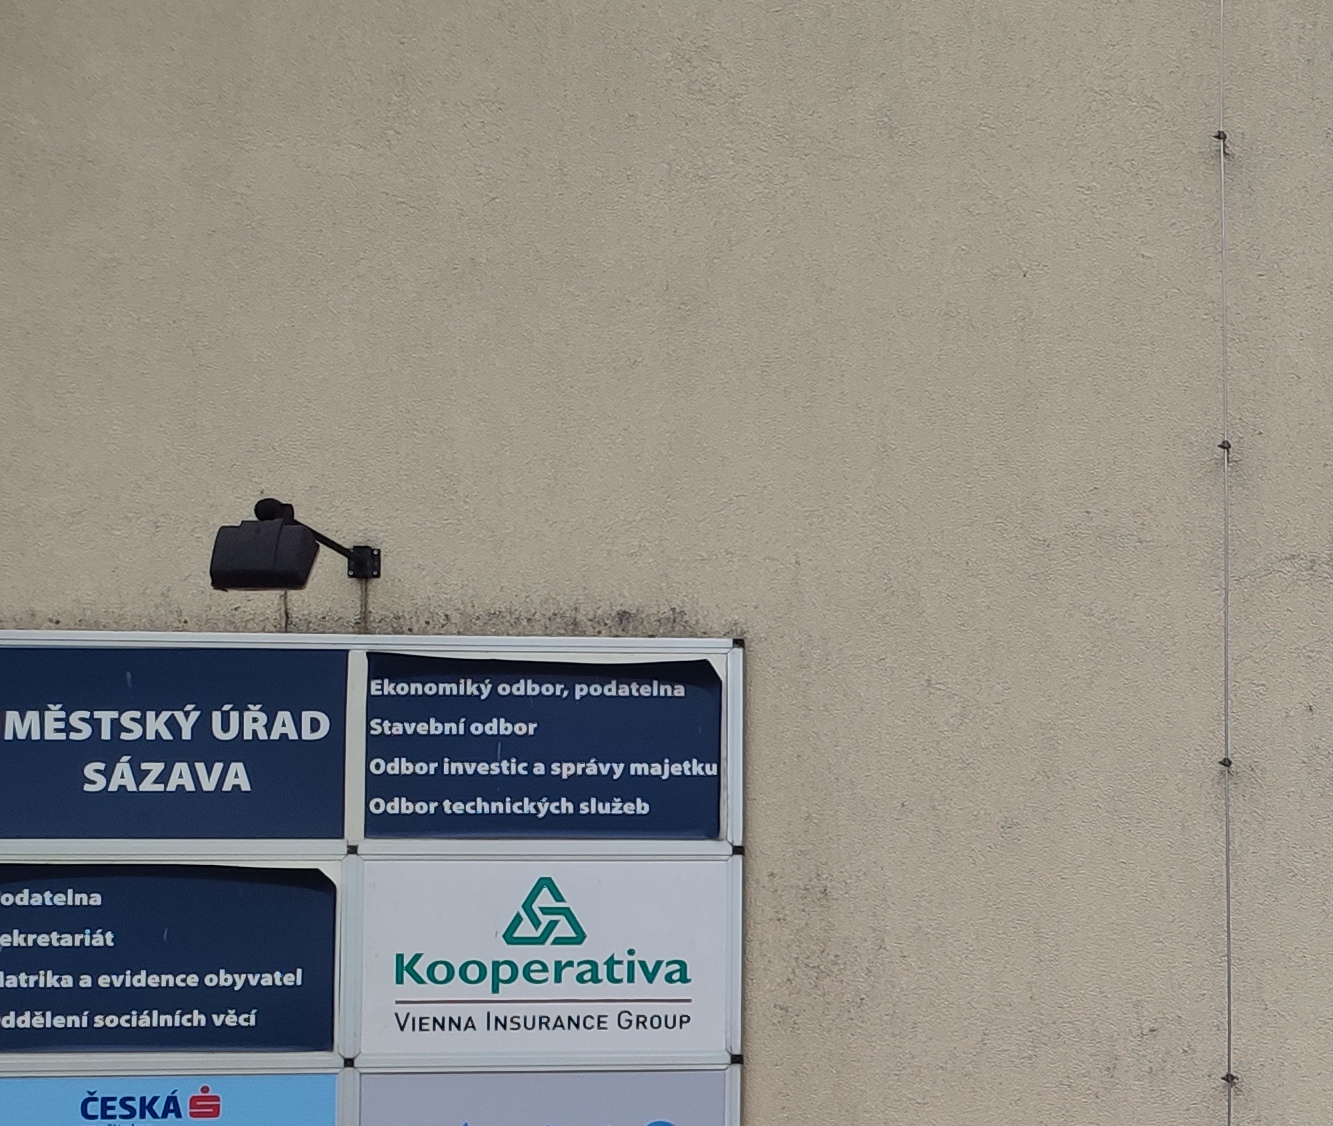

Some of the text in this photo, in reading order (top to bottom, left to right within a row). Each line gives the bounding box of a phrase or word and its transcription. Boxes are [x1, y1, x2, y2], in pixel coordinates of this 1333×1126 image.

[369, 678, 686, 701] Ekonomiký odbor, podatelna
[3, 704, 331, 741] MĚSTSKÝ ÚŘAD
[369, 718, 538, 736] Stavební odbor
[83, 755, 252, 792] SÁZAVA
[368, 757, 718, 780] Odbor investic a správy majetku
[368, 796, 650, 818] Odbor technických služeb
[0, 888, 102, 906] odatelna
[0, 929, 115, 947] ekretariát
[0, 968, 303, 991] atrika a evidence obyvatel
[395, 948, 692, 994] Kooperativa
[0, 1009, 257, 1029] ddělení sociálních věcí
[394, 1010, 692, 1032] VIENNA INSURANCE GROUP
[80, 1089, 183, 1120] ČESKÁ
